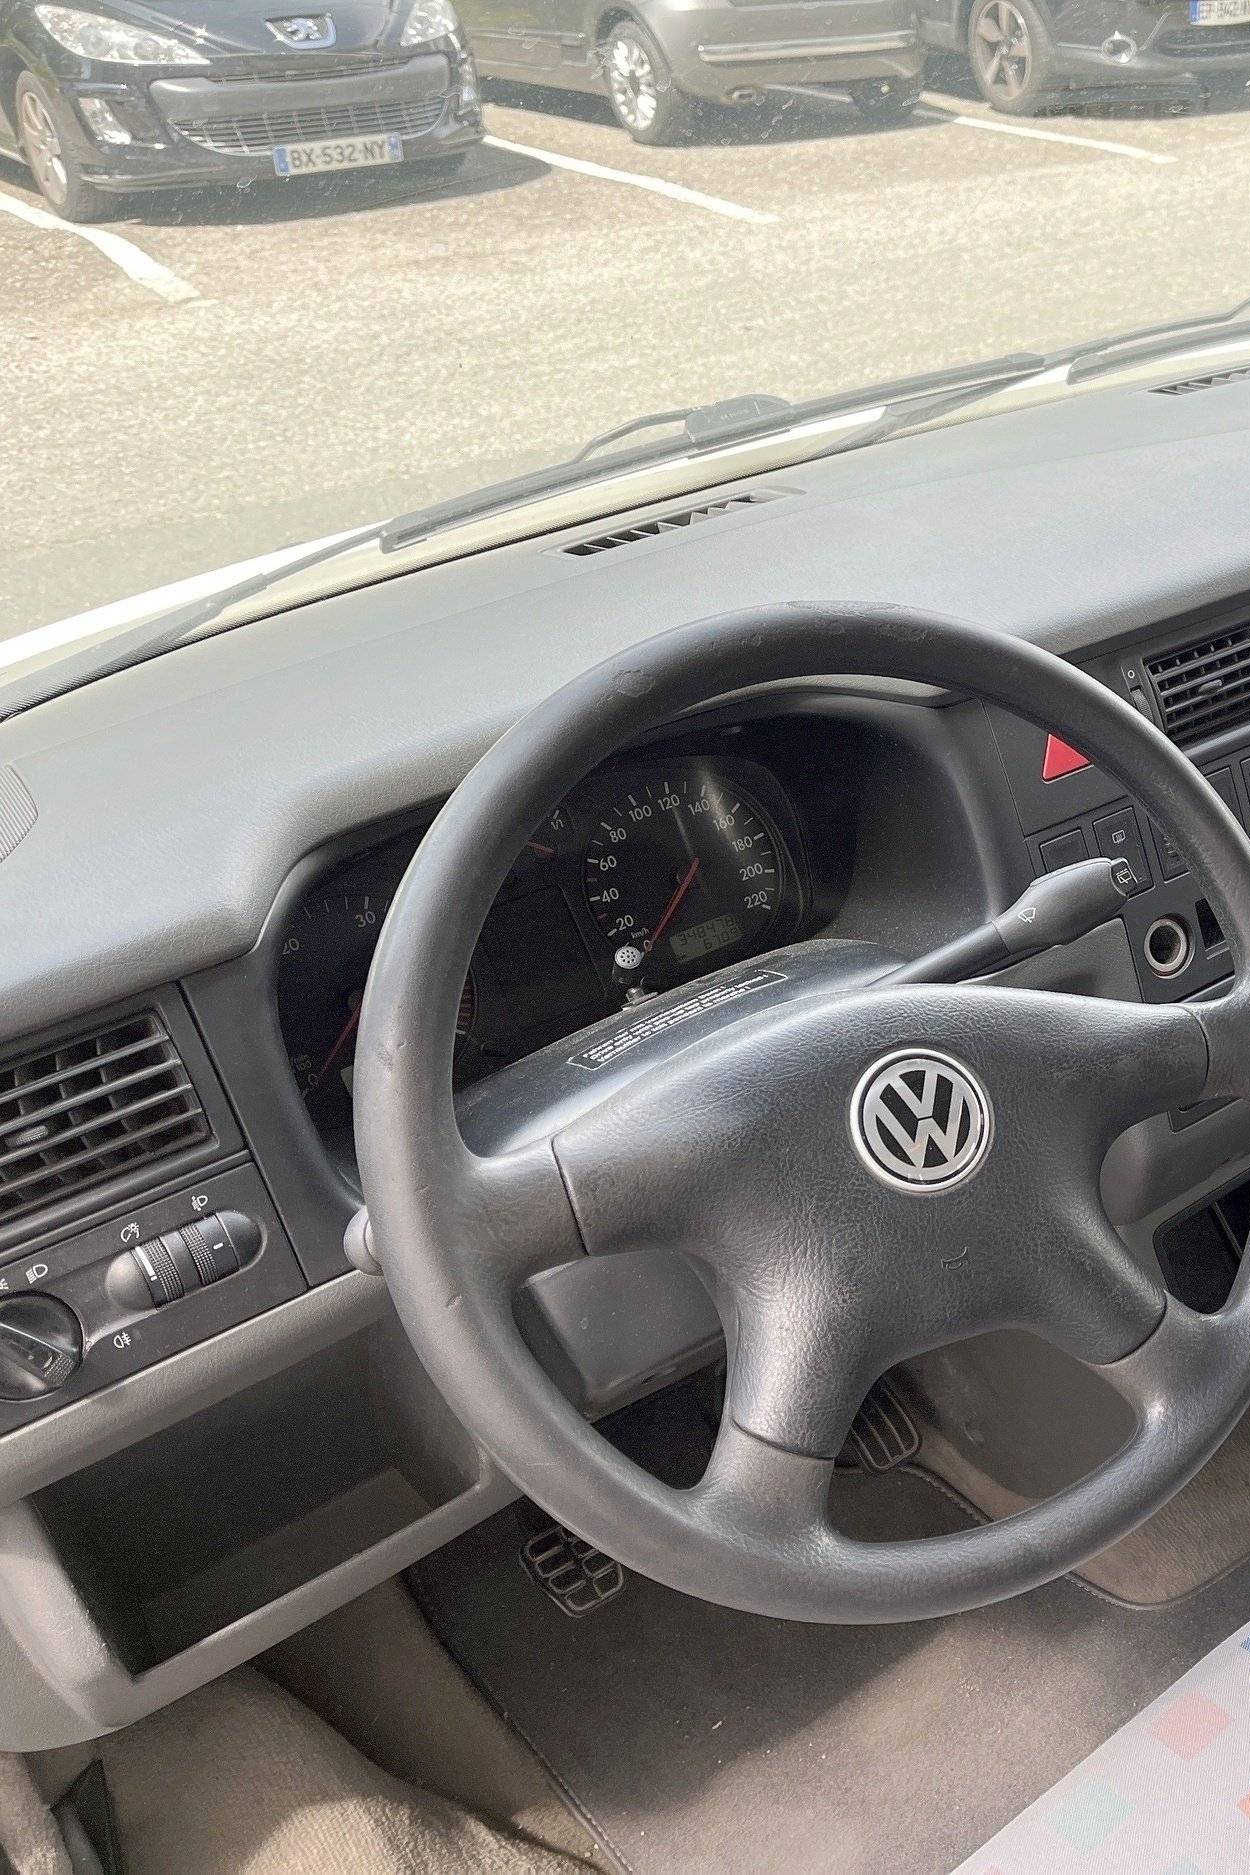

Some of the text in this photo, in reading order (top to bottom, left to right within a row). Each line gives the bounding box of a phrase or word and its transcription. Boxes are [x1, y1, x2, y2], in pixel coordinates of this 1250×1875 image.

[658, 794, 680, 811] 120
[688, 799, 710, 816] 140
[629, 805, 652, 822] 100
[713, 814, 735, 831] 160
[609, 828, 627, 843] 80
[732, 837, 753, 852] 180
[599, 855, 617, 871] 60
[739, 863, 763, 881] 200
[602, 888, 619, 903] 40
[744, 891, 768, 909] 220
[354, 911, 376, 928] 30
[616, 915, 634, 931] 20
[631, 927, 650, 940] km/h
